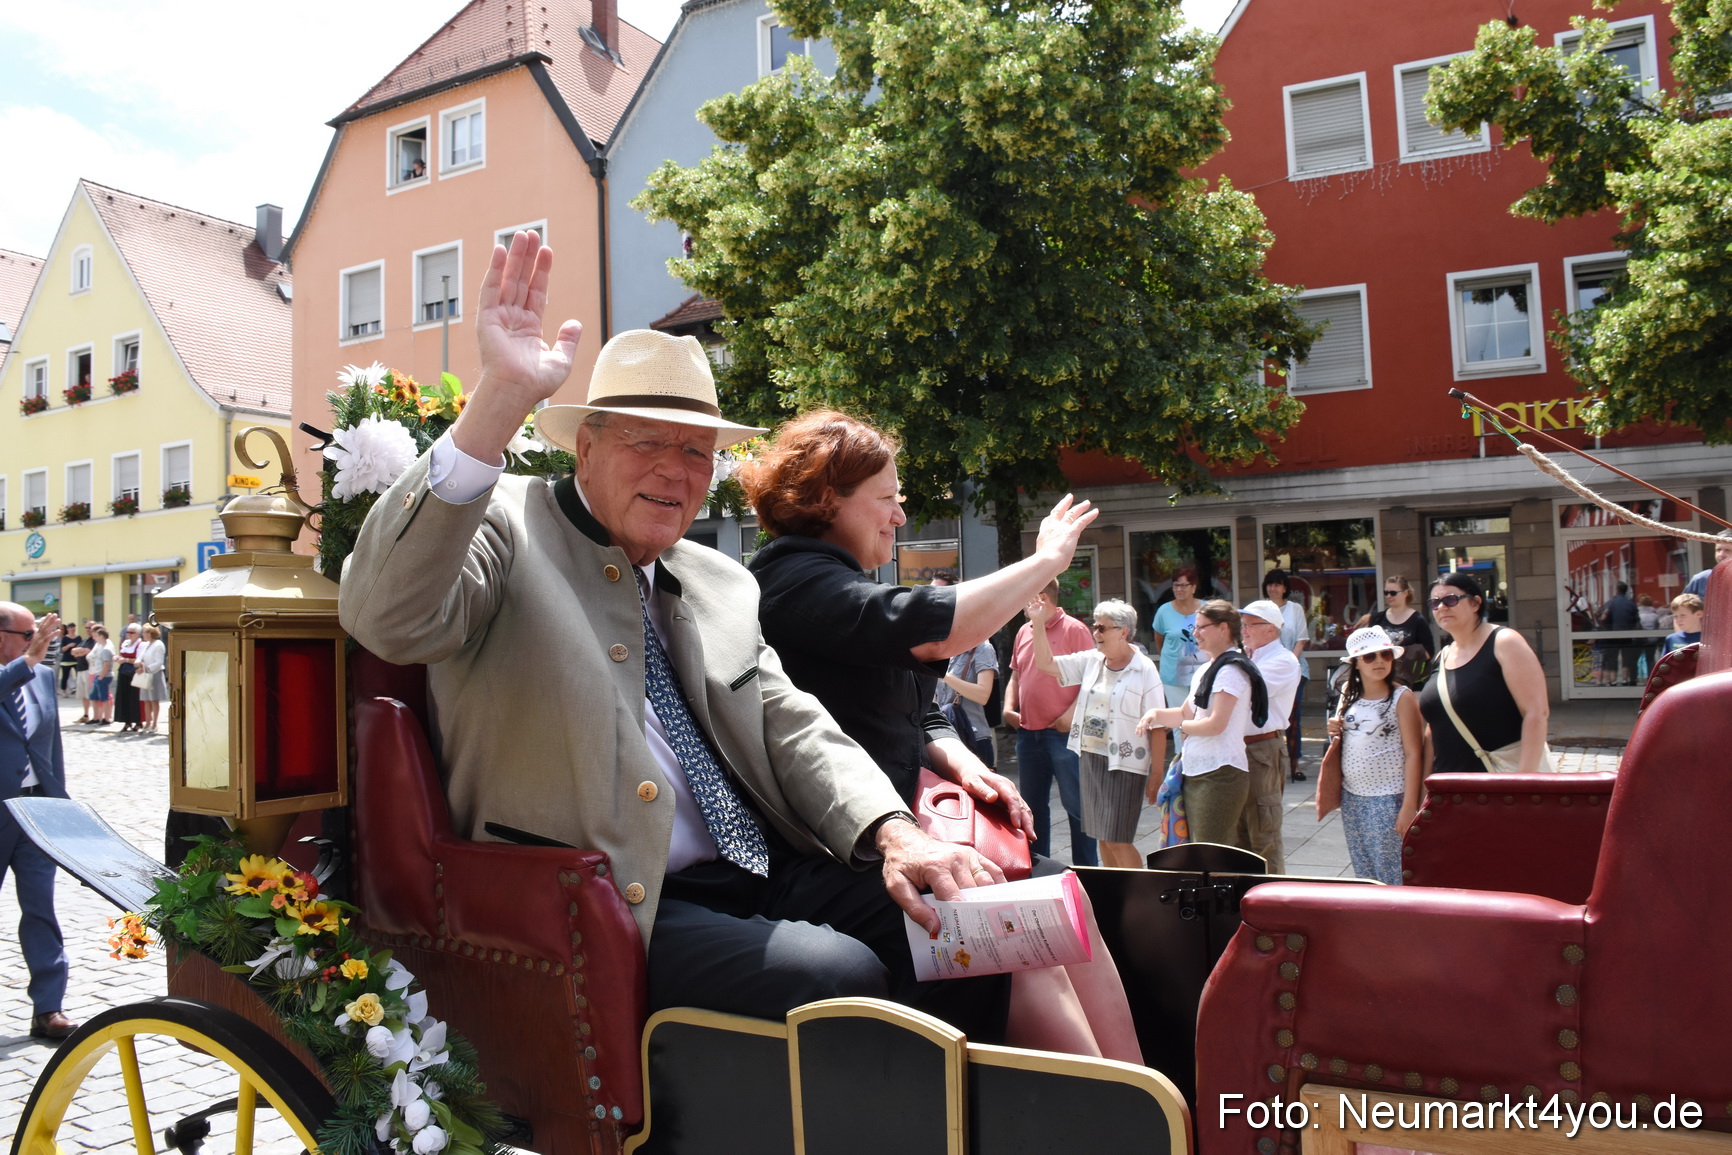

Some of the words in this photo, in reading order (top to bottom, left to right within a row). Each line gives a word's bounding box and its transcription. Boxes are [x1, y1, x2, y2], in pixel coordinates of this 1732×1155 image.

[1461, 395, 1605, 437] TAKK
[235, 477, 249, 486] KINO
[204, 545, 220, 569] P
[952, 908, 963, 940] NEUMARKT
